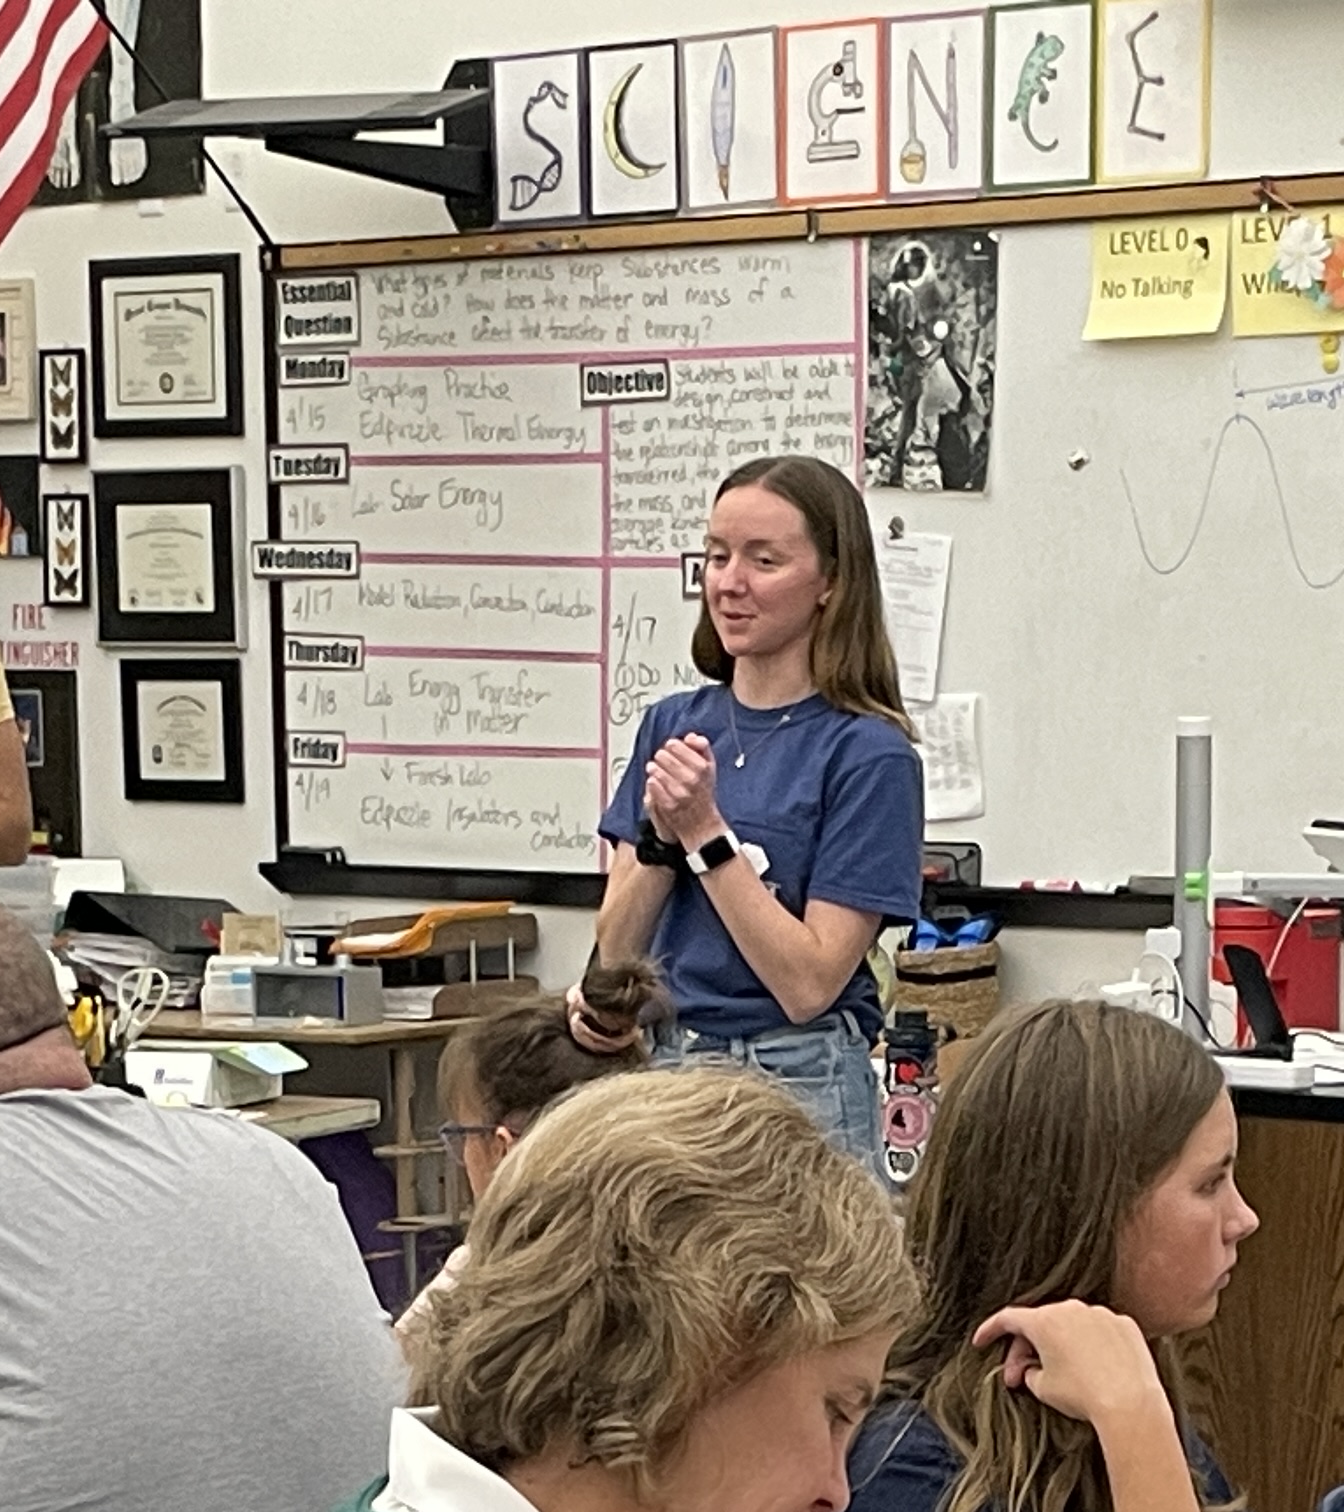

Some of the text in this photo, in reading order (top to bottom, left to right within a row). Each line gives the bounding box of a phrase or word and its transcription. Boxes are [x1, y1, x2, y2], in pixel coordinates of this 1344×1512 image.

[1109, 230, 1169, 255] LEVEL
[281, 281, 352, 304] Essential
[1101, 276, 1194, 299] No Talking
[284, 313, 353, 338] Question
[285, 357, 345, 381] Monday
[587, 369, 664, 396] Objective
[273, 453, 341, 477] Tuesday
[257, 547, 353, 571] Wednesday
[12, 604, 46, 631] FIRE
[288, 640, 359, 666] Thursday
[292, 737, 340, 763] Friday
